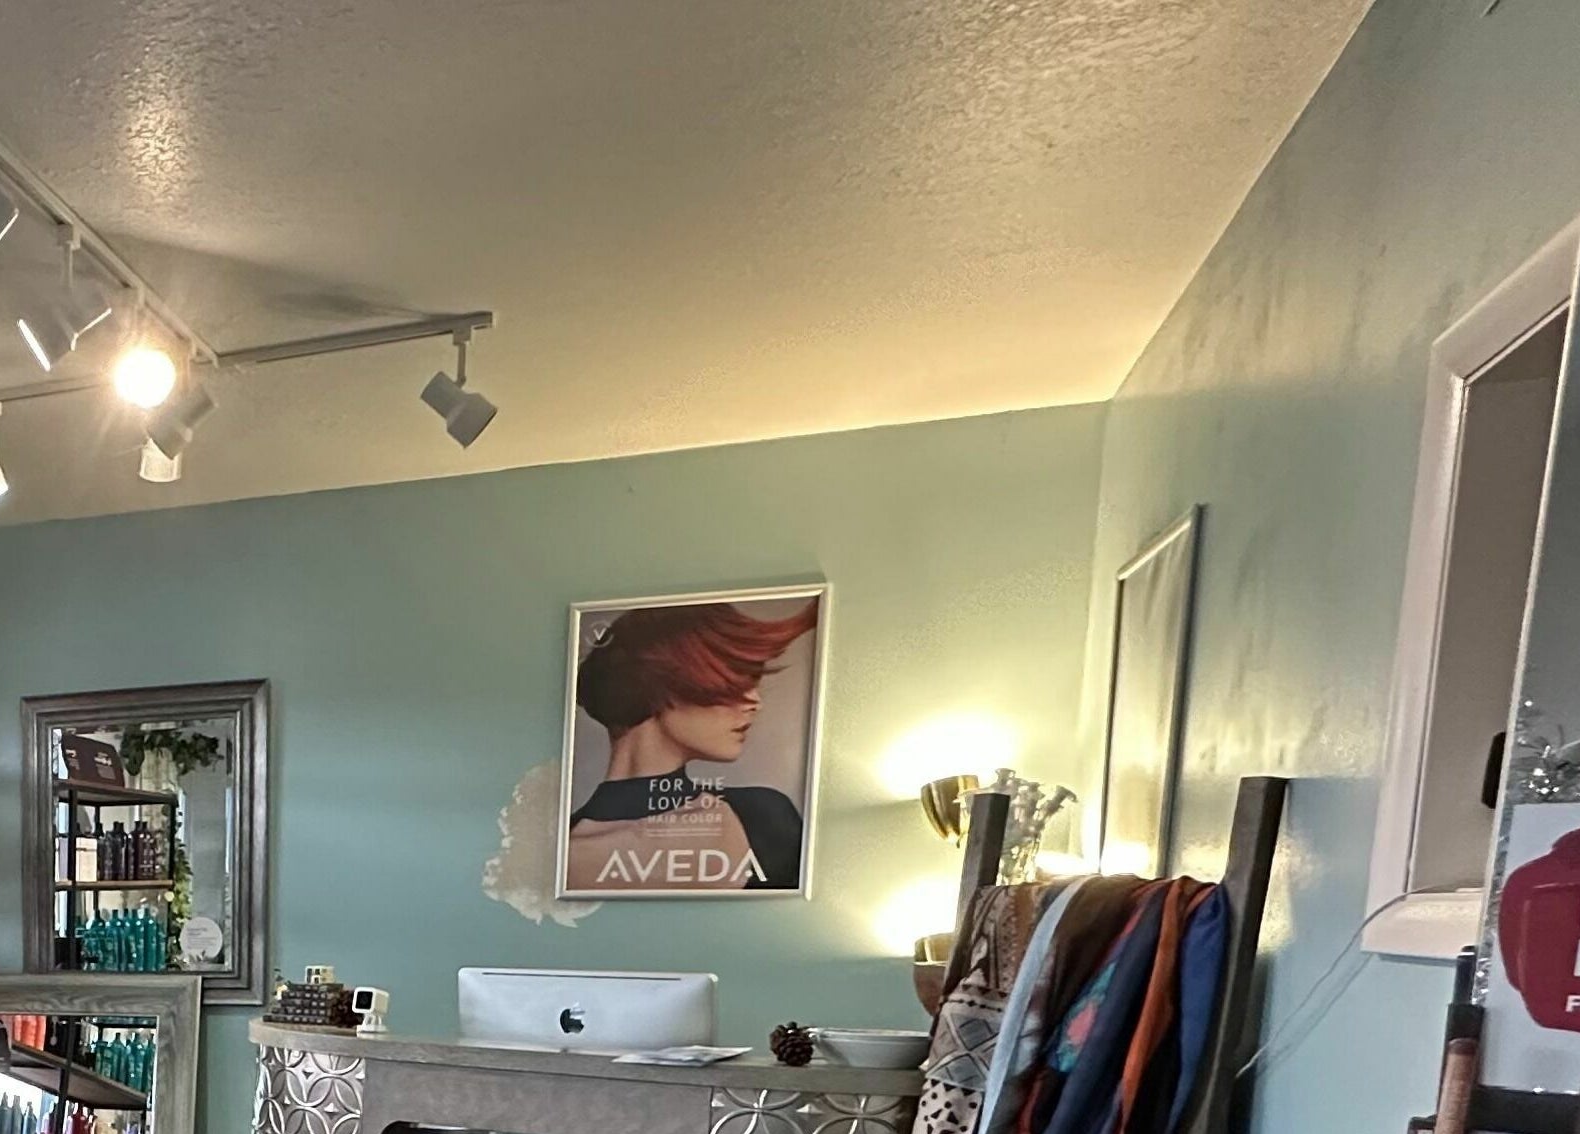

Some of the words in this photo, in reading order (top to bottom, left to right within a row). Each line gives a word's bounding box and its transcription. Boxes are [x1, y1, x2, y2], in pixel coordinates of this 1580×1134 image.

[649, 778, 684, 793] FOR
[691, 776, 726, 791] THE
[647, 796, 694, 811] LOVE
[700, 795, 725, 810] OF
[647, 814, 678, 825] HAIR
[681, 812, 724, 824] COLOR
[596, 848, 768, 883] AVEDA
